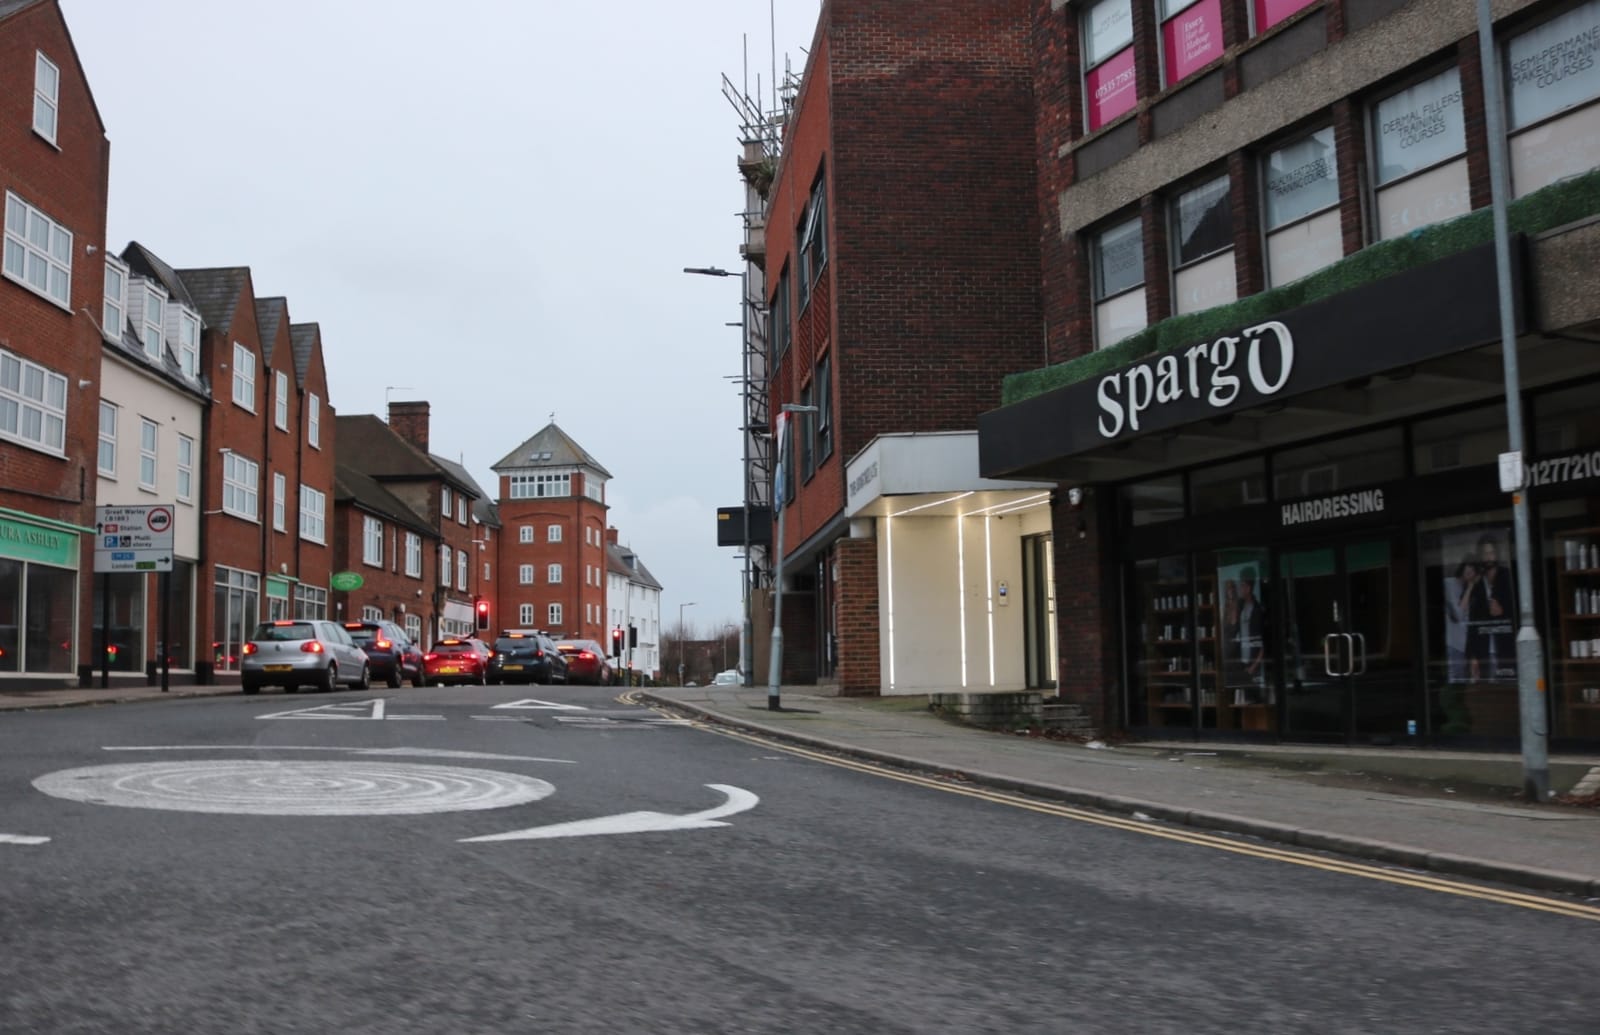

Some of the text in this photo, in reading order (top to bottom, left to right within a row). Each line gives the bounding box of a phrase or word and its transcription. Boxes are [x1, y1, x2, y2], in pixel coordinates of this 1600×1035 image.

[1536, 55, 1594, 89] COURSES
[1383, 91, 1461, 135] DERMAL FILLERS
[1400, 121, 1446, 149] COURSES
[1282, 489, 1385, 525] HAIRDRESSING
[26, 529, 60, 549] ASHLEY
